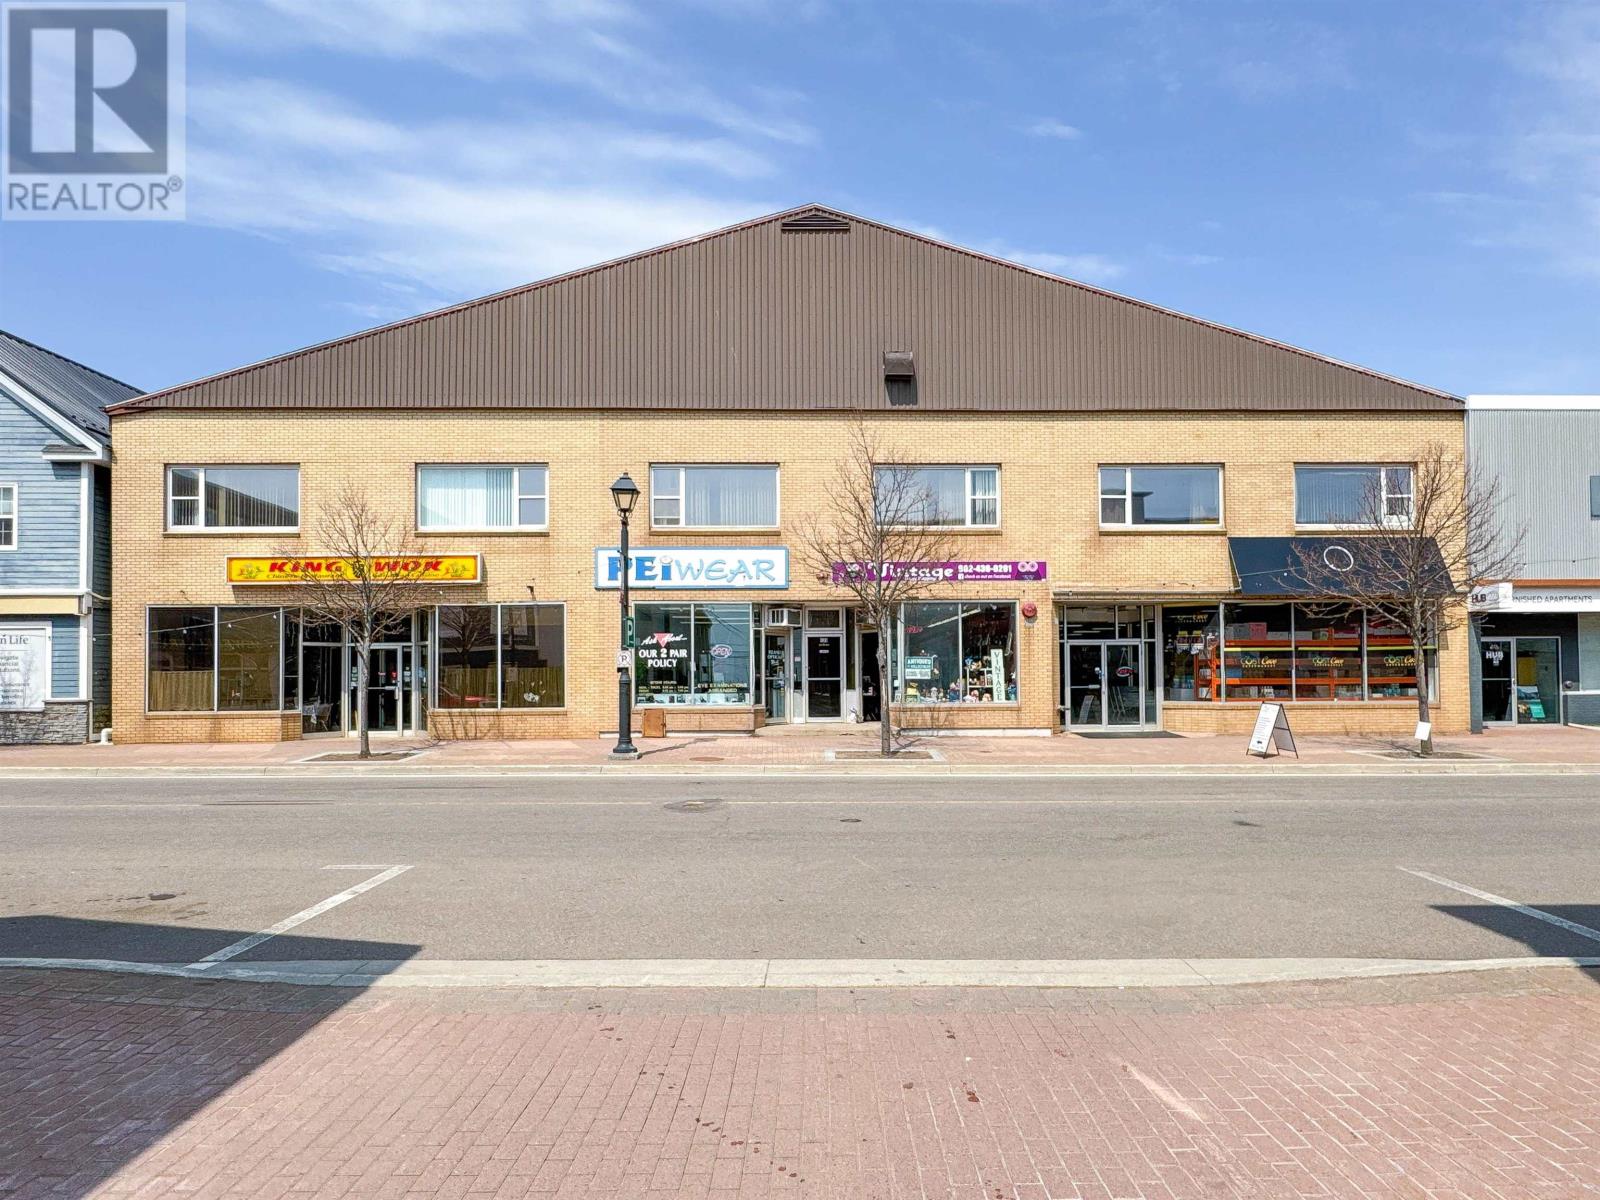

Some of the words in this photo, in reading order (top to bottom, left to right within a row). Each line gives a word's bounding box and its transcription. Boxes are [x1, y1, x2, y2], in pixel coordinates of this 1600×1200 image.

[268, 561, 343, 572] KING
[374, 560, 442, 571] WOK
[1471, 593, 1487, 604] HUB
[1545, 595, 1593, 604] APARTMENTS
[10, 635, 29, 645] Life
[641, 635, 658, 645] Ask
[639, 649, 657, 658] OUR
[660, 648, 667, 658] 2
[669, 649, 688, 658] PAIR
[711, 646, 732, 656] OPEN
[647, 659, 677, 667] POLICY
[993, 651, 1004, 701] VINTAGE
